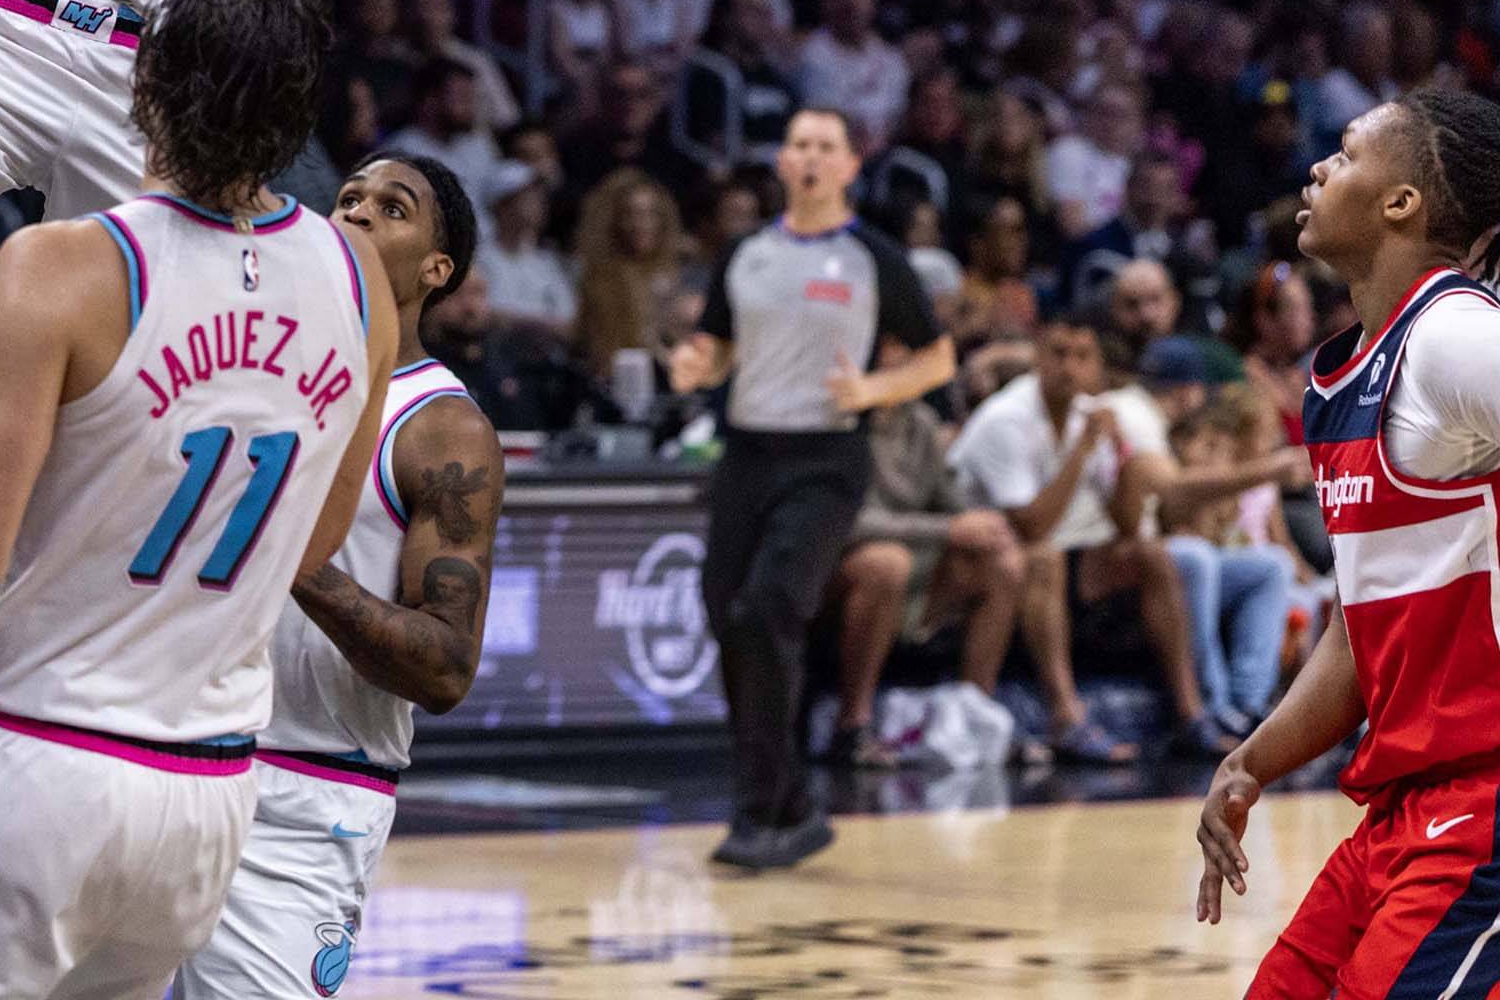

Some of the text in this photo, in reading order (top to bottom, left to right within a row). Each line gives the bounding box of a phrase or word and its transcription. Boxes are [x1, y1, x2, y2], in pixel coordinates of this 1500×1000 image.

[138, 311, 352, 431] JAQUEZ JR.
[128, 426, 301, 592] 11
